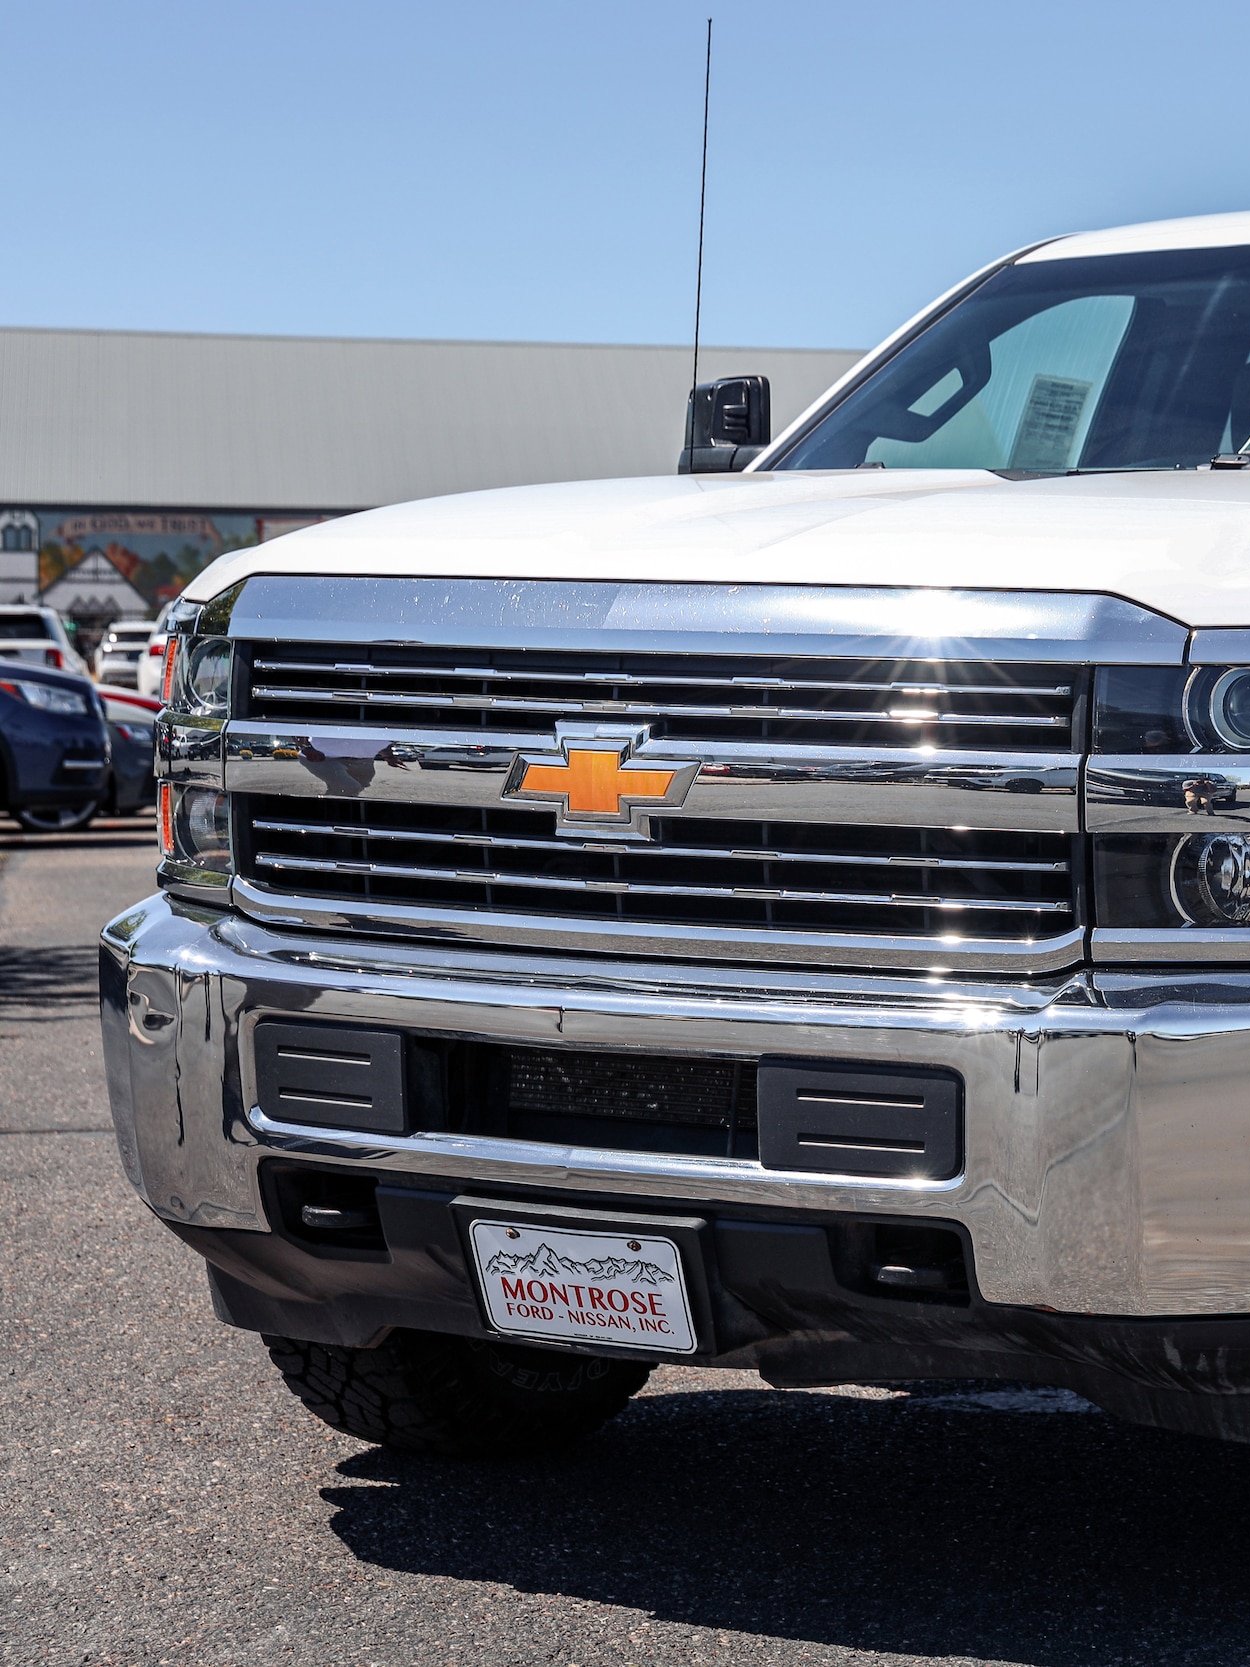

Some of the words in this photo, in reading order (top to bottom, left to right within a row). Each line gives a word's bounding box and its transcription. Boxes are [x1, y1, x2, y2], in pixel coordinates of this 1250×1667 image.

[501, 1276, 667, 1317] MONTROSE
[506, 1302, 554, 1321] FORD
[568, 1310, 637, 1333] NISSAN,
[639, 1318, 675, 1336] INC.
